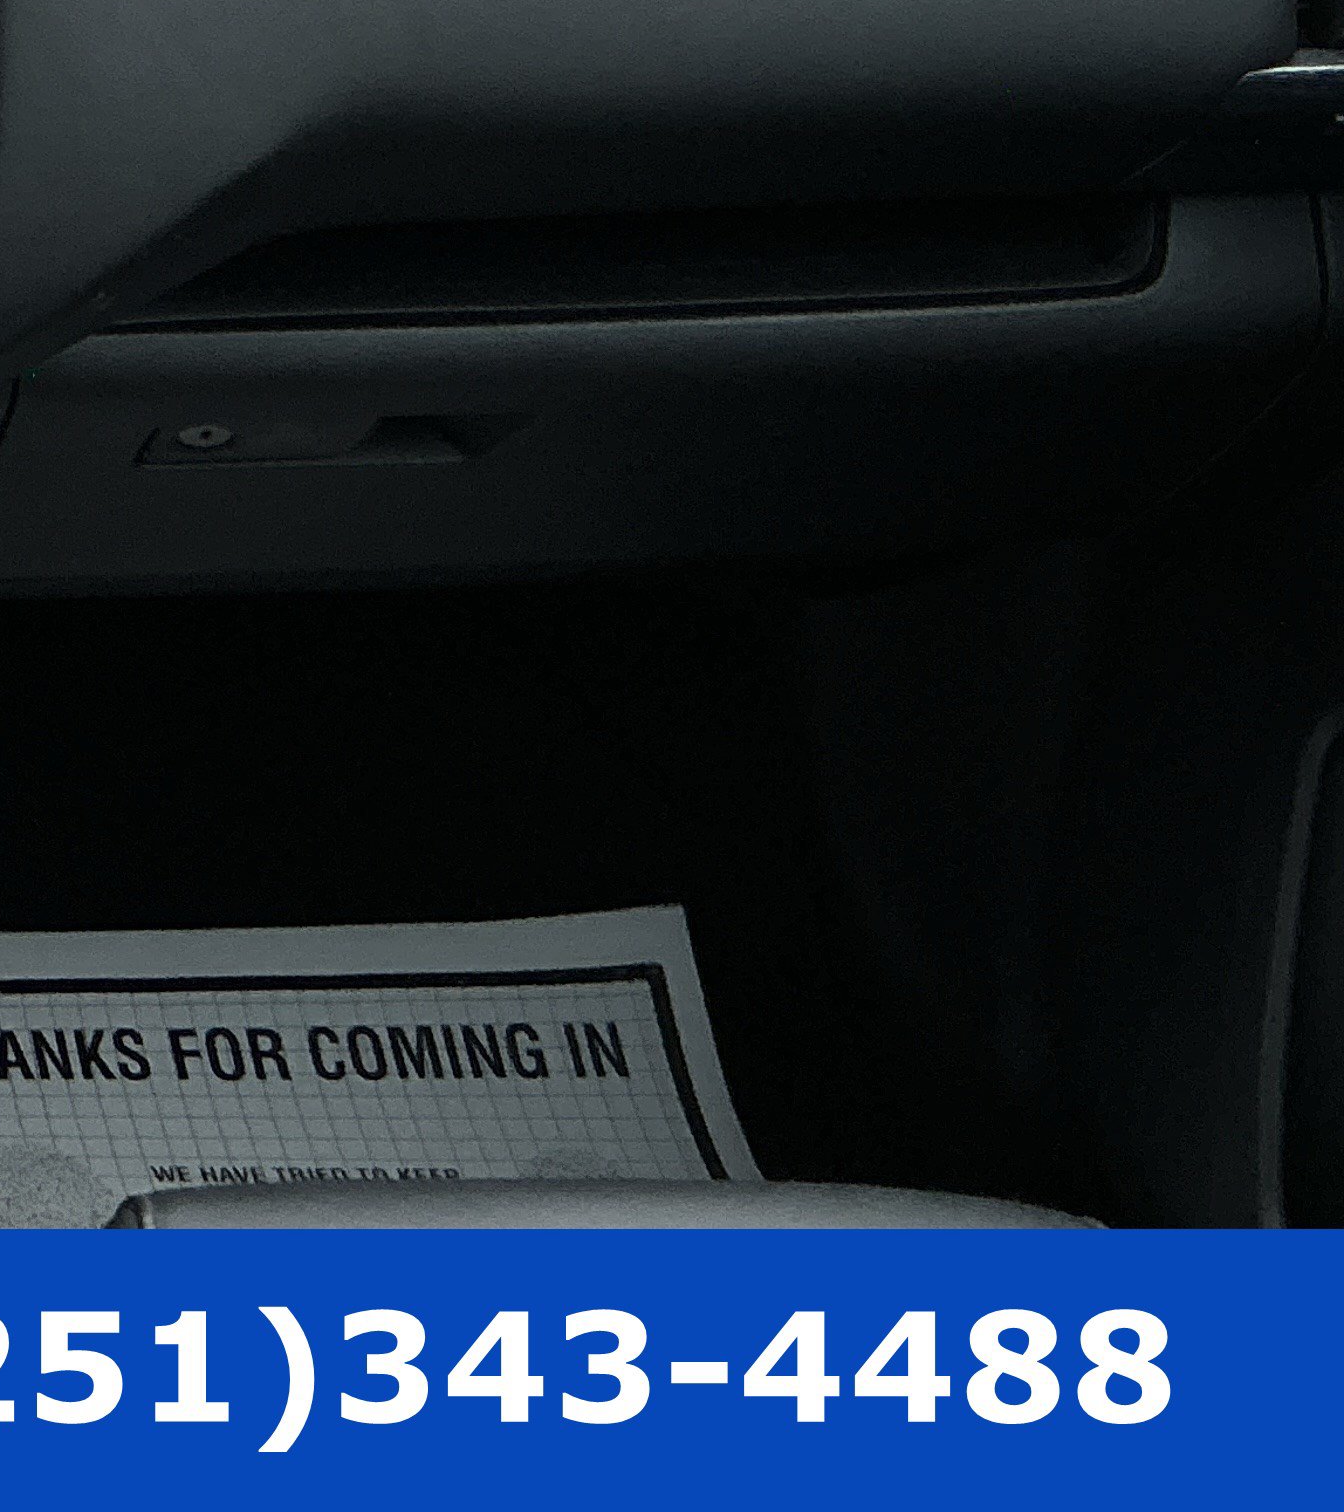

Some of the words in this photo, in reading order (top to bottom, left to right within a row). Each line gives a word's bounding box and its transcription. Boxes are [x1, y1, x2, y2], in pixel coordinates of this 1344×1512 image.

[170, 1026, 293, 1083] FOR
[308, 1022, 550, 1082] COMING
[564, 1022, 631, 1081] IN
[150, 1164, 189, 1185] WE
[199, 1165, 264, 1183] HAVE
